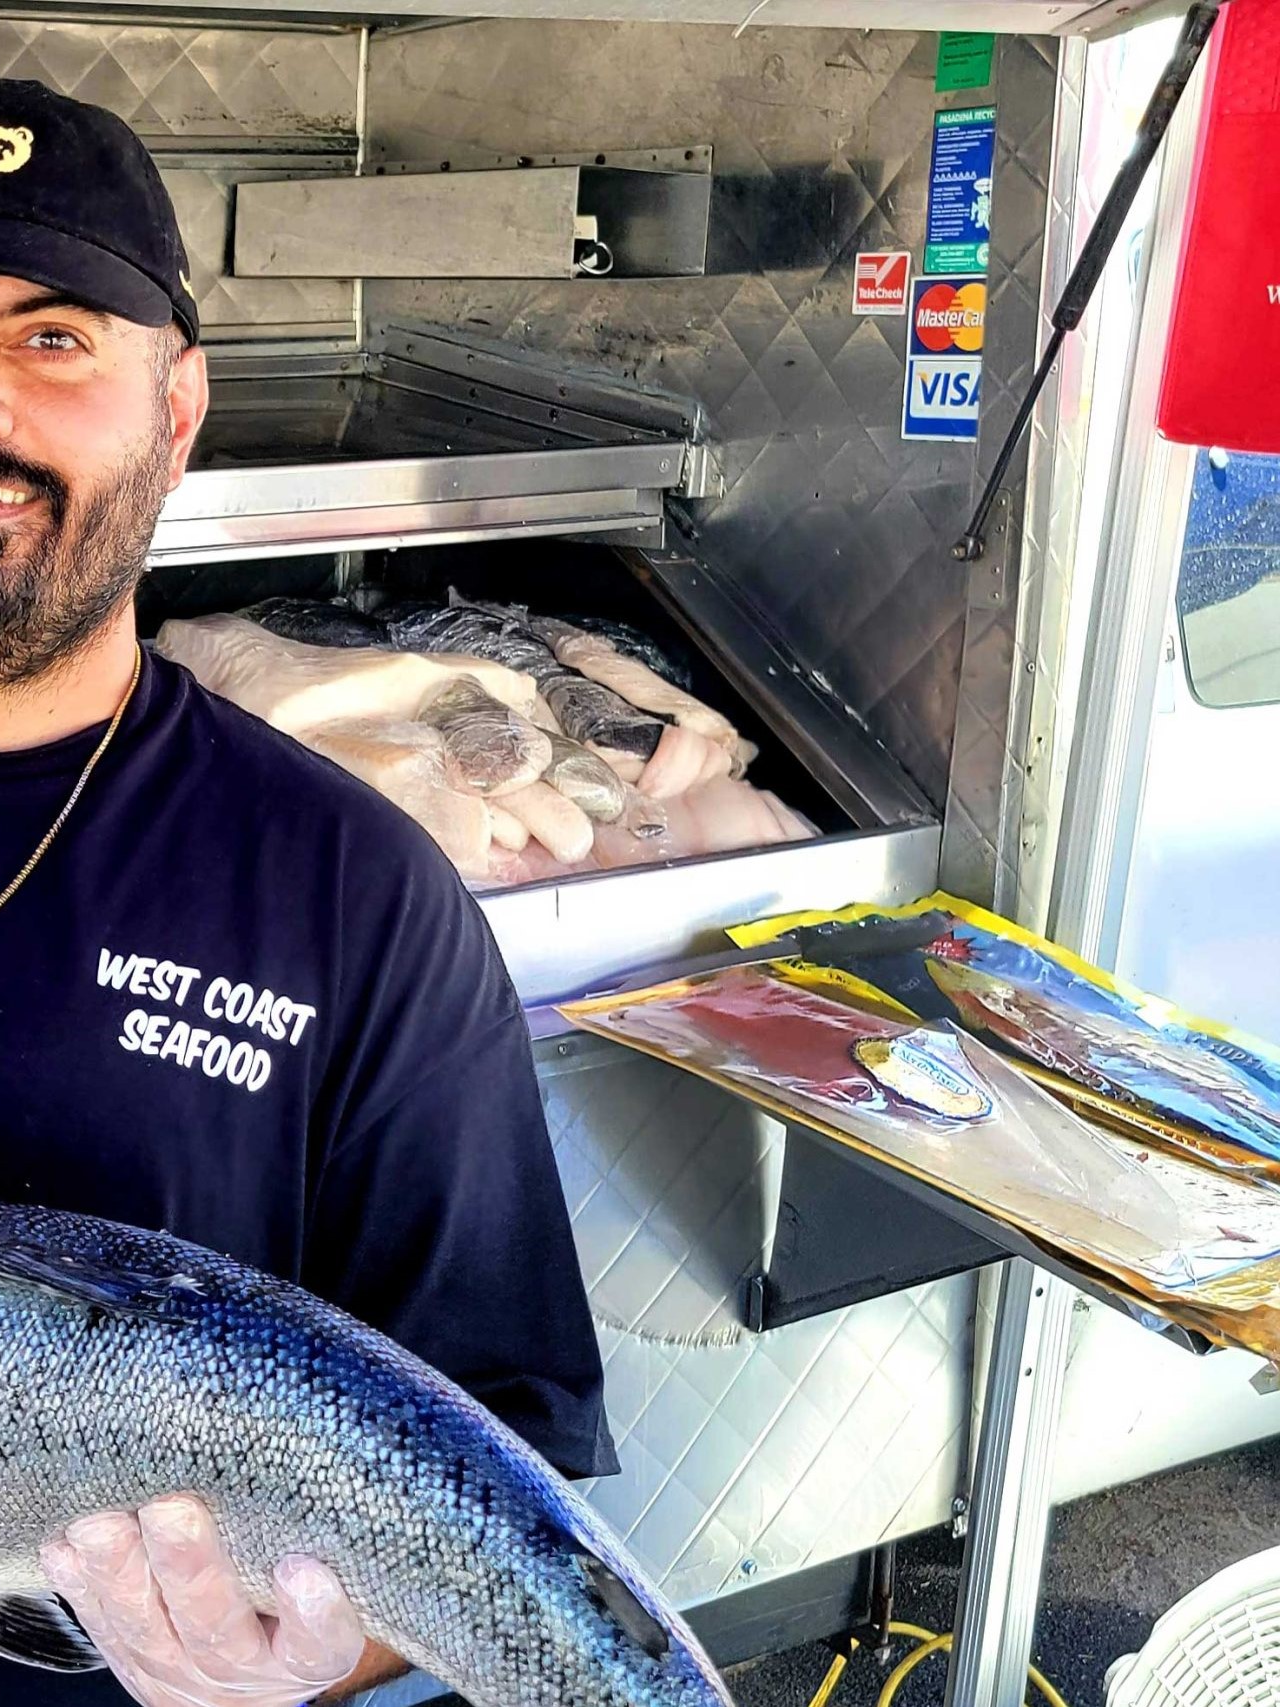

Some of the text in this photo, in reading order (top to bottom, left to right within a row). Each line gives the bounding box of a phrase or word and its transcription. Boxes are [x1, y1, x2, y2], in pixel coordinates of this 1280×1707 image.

[859, 287, 902, 299] TeleCheck
[97, 948, 316, 1045] WEST COAST
[119, 1009, 271, 1091] SEAFOOD
